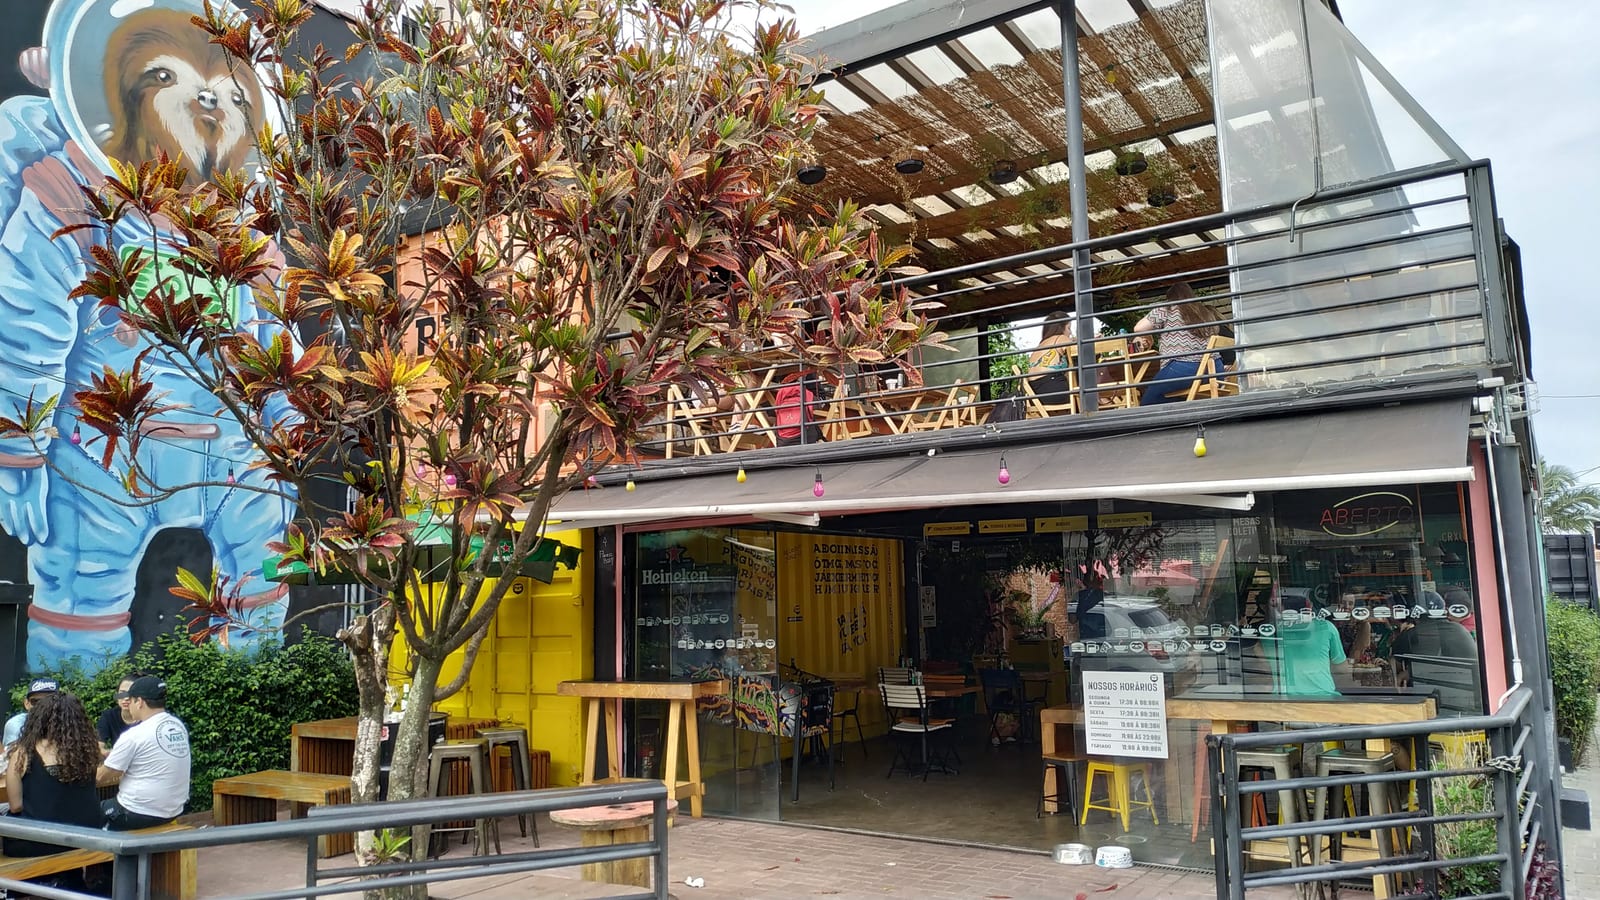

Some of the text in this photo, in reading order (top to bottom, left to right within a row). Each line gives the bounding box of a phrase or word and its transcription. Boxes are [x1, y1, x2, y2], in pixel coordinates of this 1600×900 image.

[1320, 505, 1413, 526] ABERTO
[642, 568, 708, 585] Heineken
[1088, 681, 1158, 692] NOSSOS HORÁRIOS
